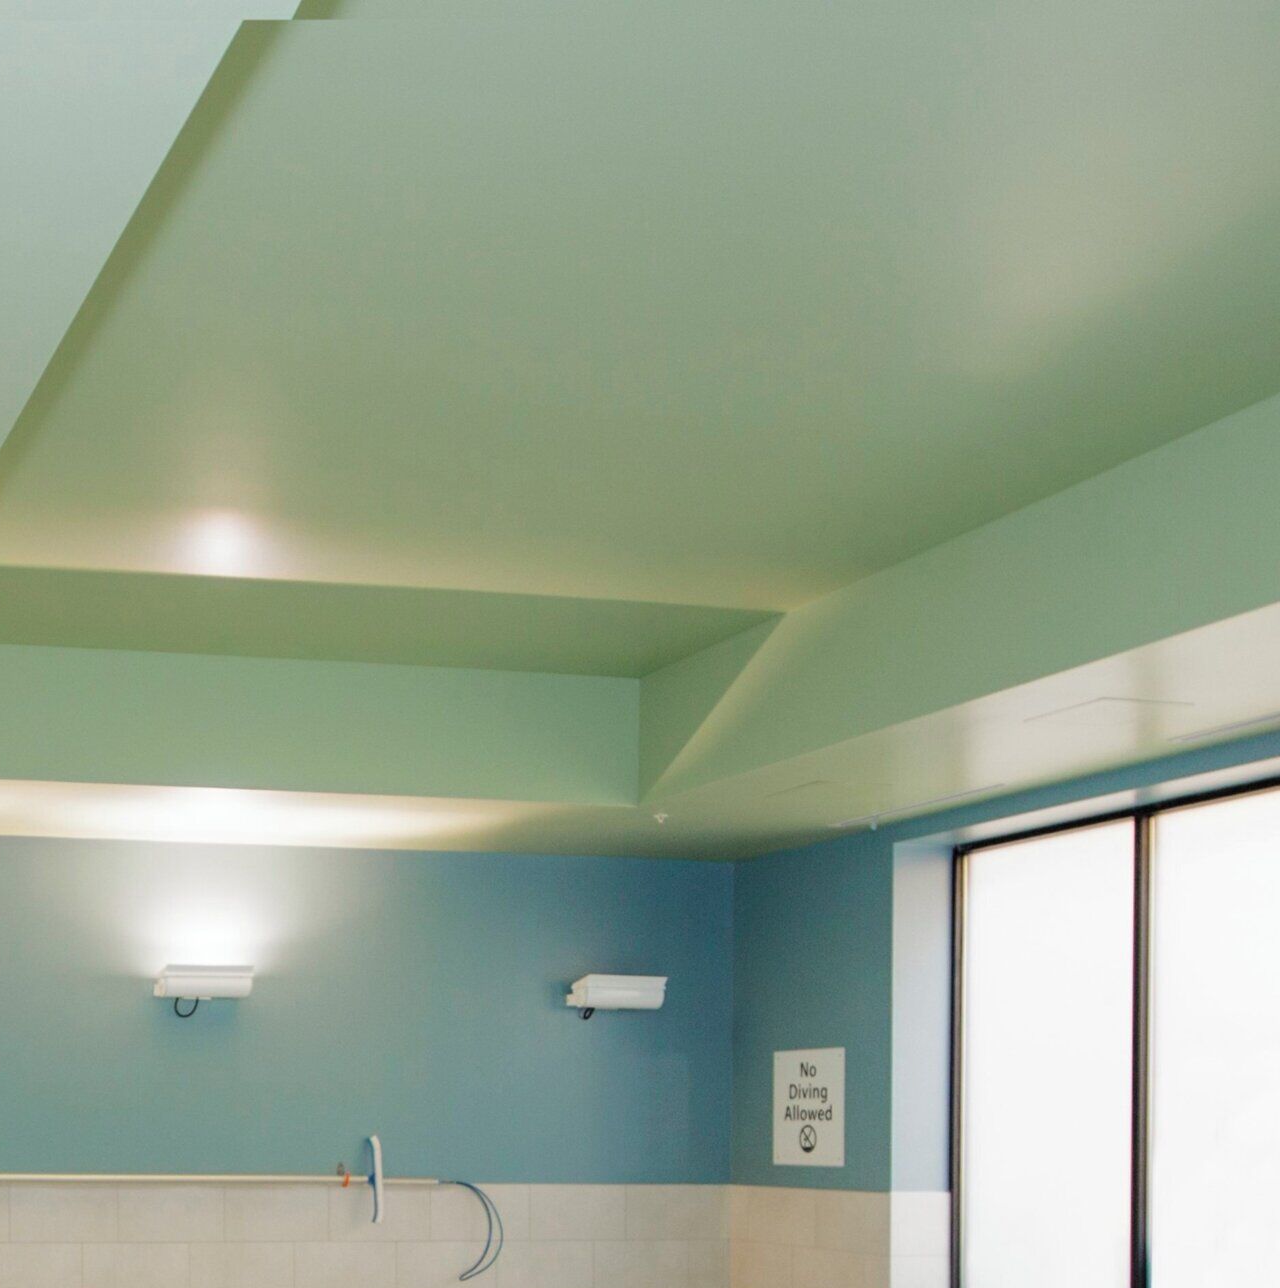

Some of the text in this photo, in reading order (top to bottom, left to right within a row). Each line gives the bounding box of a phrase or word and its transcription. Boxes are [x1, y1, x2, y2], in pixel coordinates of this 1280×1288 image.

[800, 1062, 817, 1078] No
[789, 1083, 828, 1103] Diving
[784, 1105, 833, 1121] Allowed
